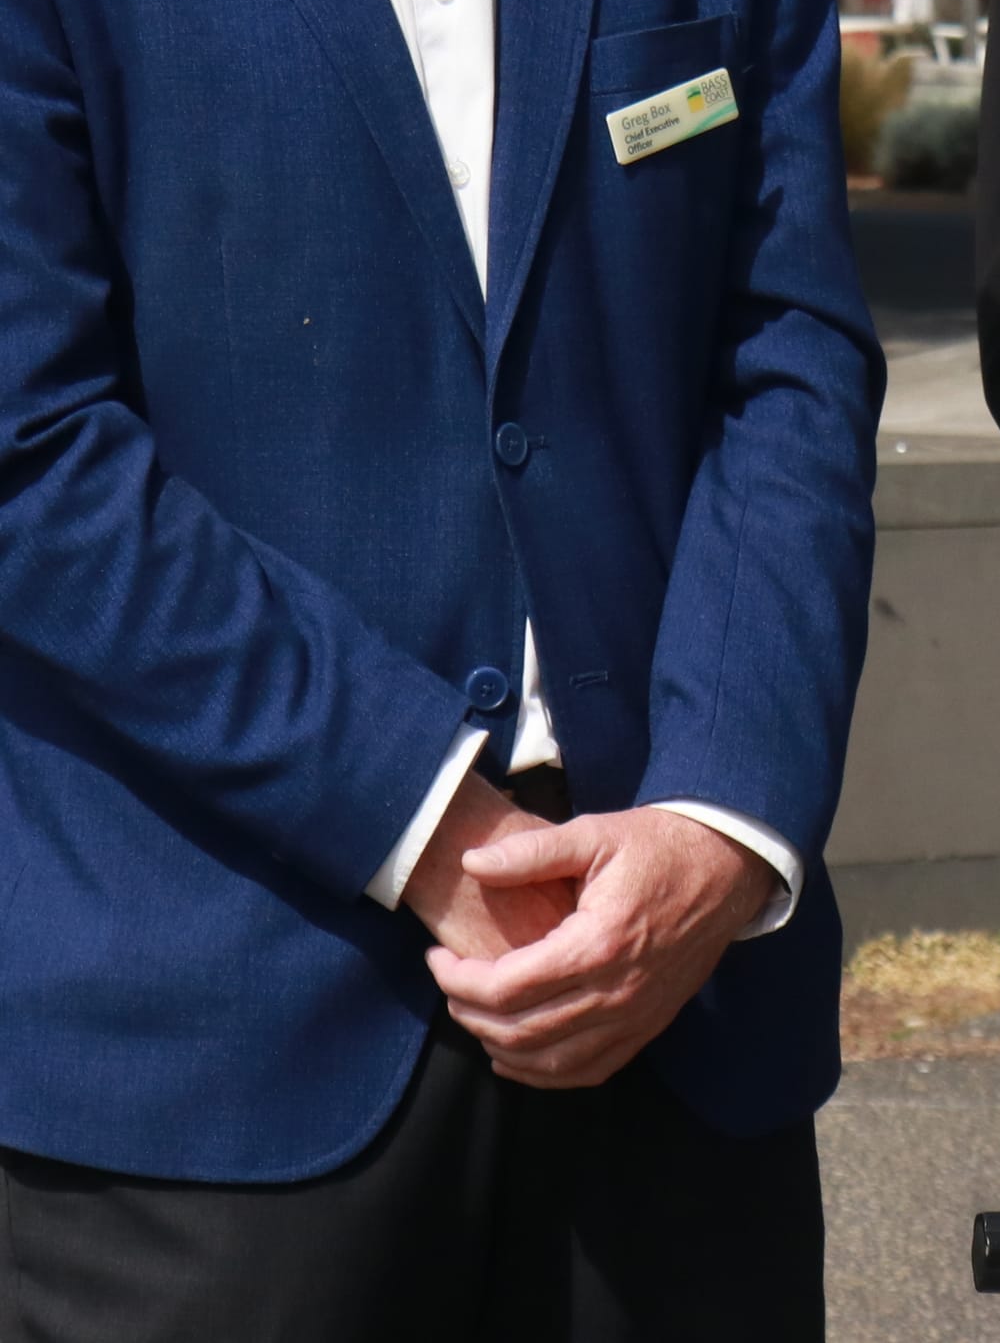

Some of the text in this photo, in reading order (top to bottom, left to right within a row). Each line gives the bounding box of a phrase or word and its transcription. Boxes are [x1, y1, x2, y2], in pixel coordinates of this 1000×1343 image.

[701, 74, 728, 94] BASS
[705, 88, 729, 105] COAST
[622, 102, 672, 130] Greg Box
[625, 116, 681, 145] Chief Executive
[628, 138, 653, 155] Officer
